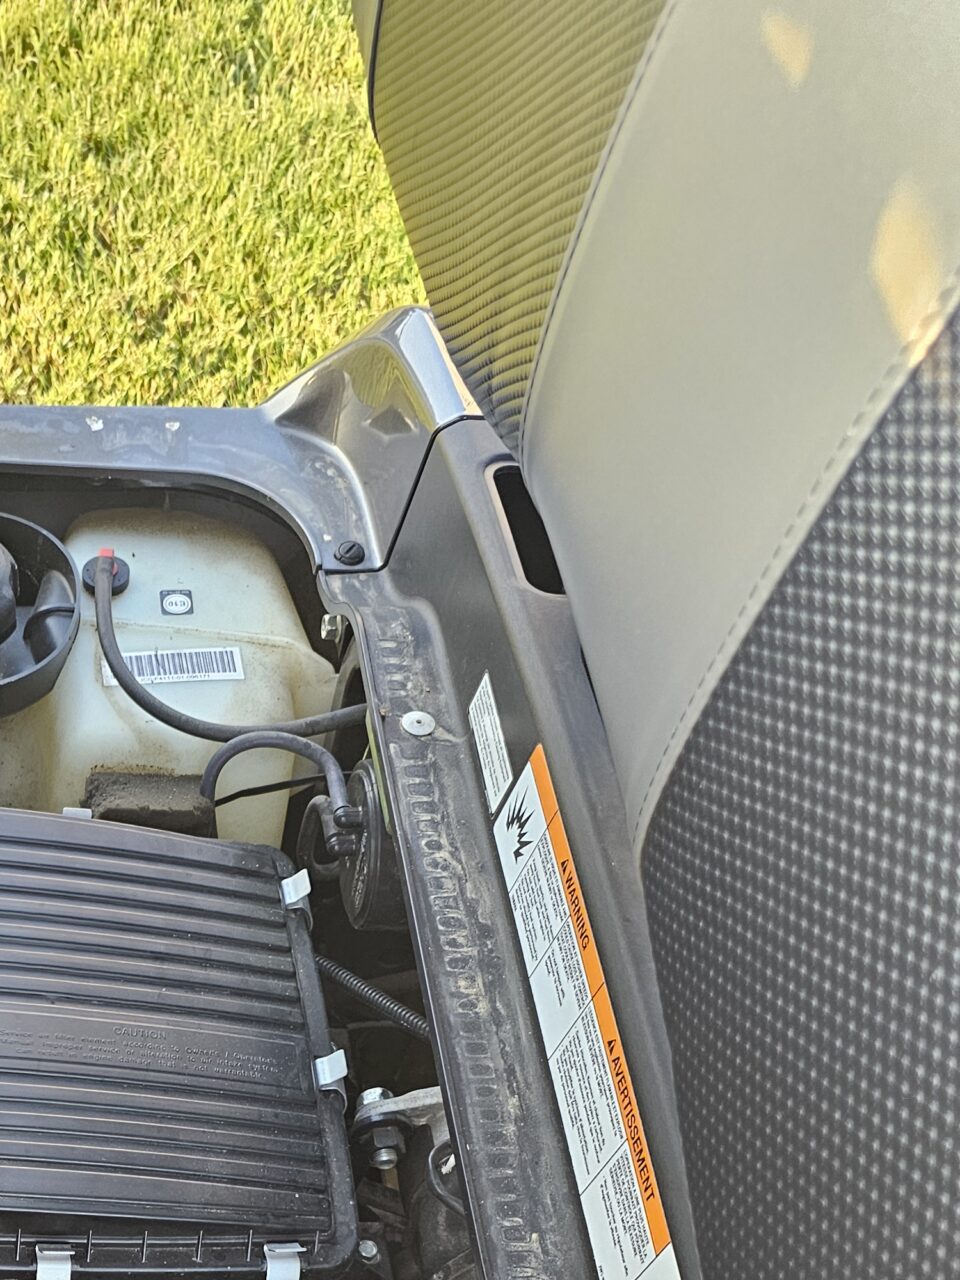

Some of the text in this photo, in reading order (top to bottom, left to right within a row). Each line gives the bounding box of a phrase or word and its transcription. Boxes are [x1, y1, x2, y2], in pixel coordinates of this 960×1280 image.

[564, 870, 590, 952] WARNING
[113, 1026, 167, 1040] CAUTION
[610, 1051, 656, 1205] AVERTISSEMENT
